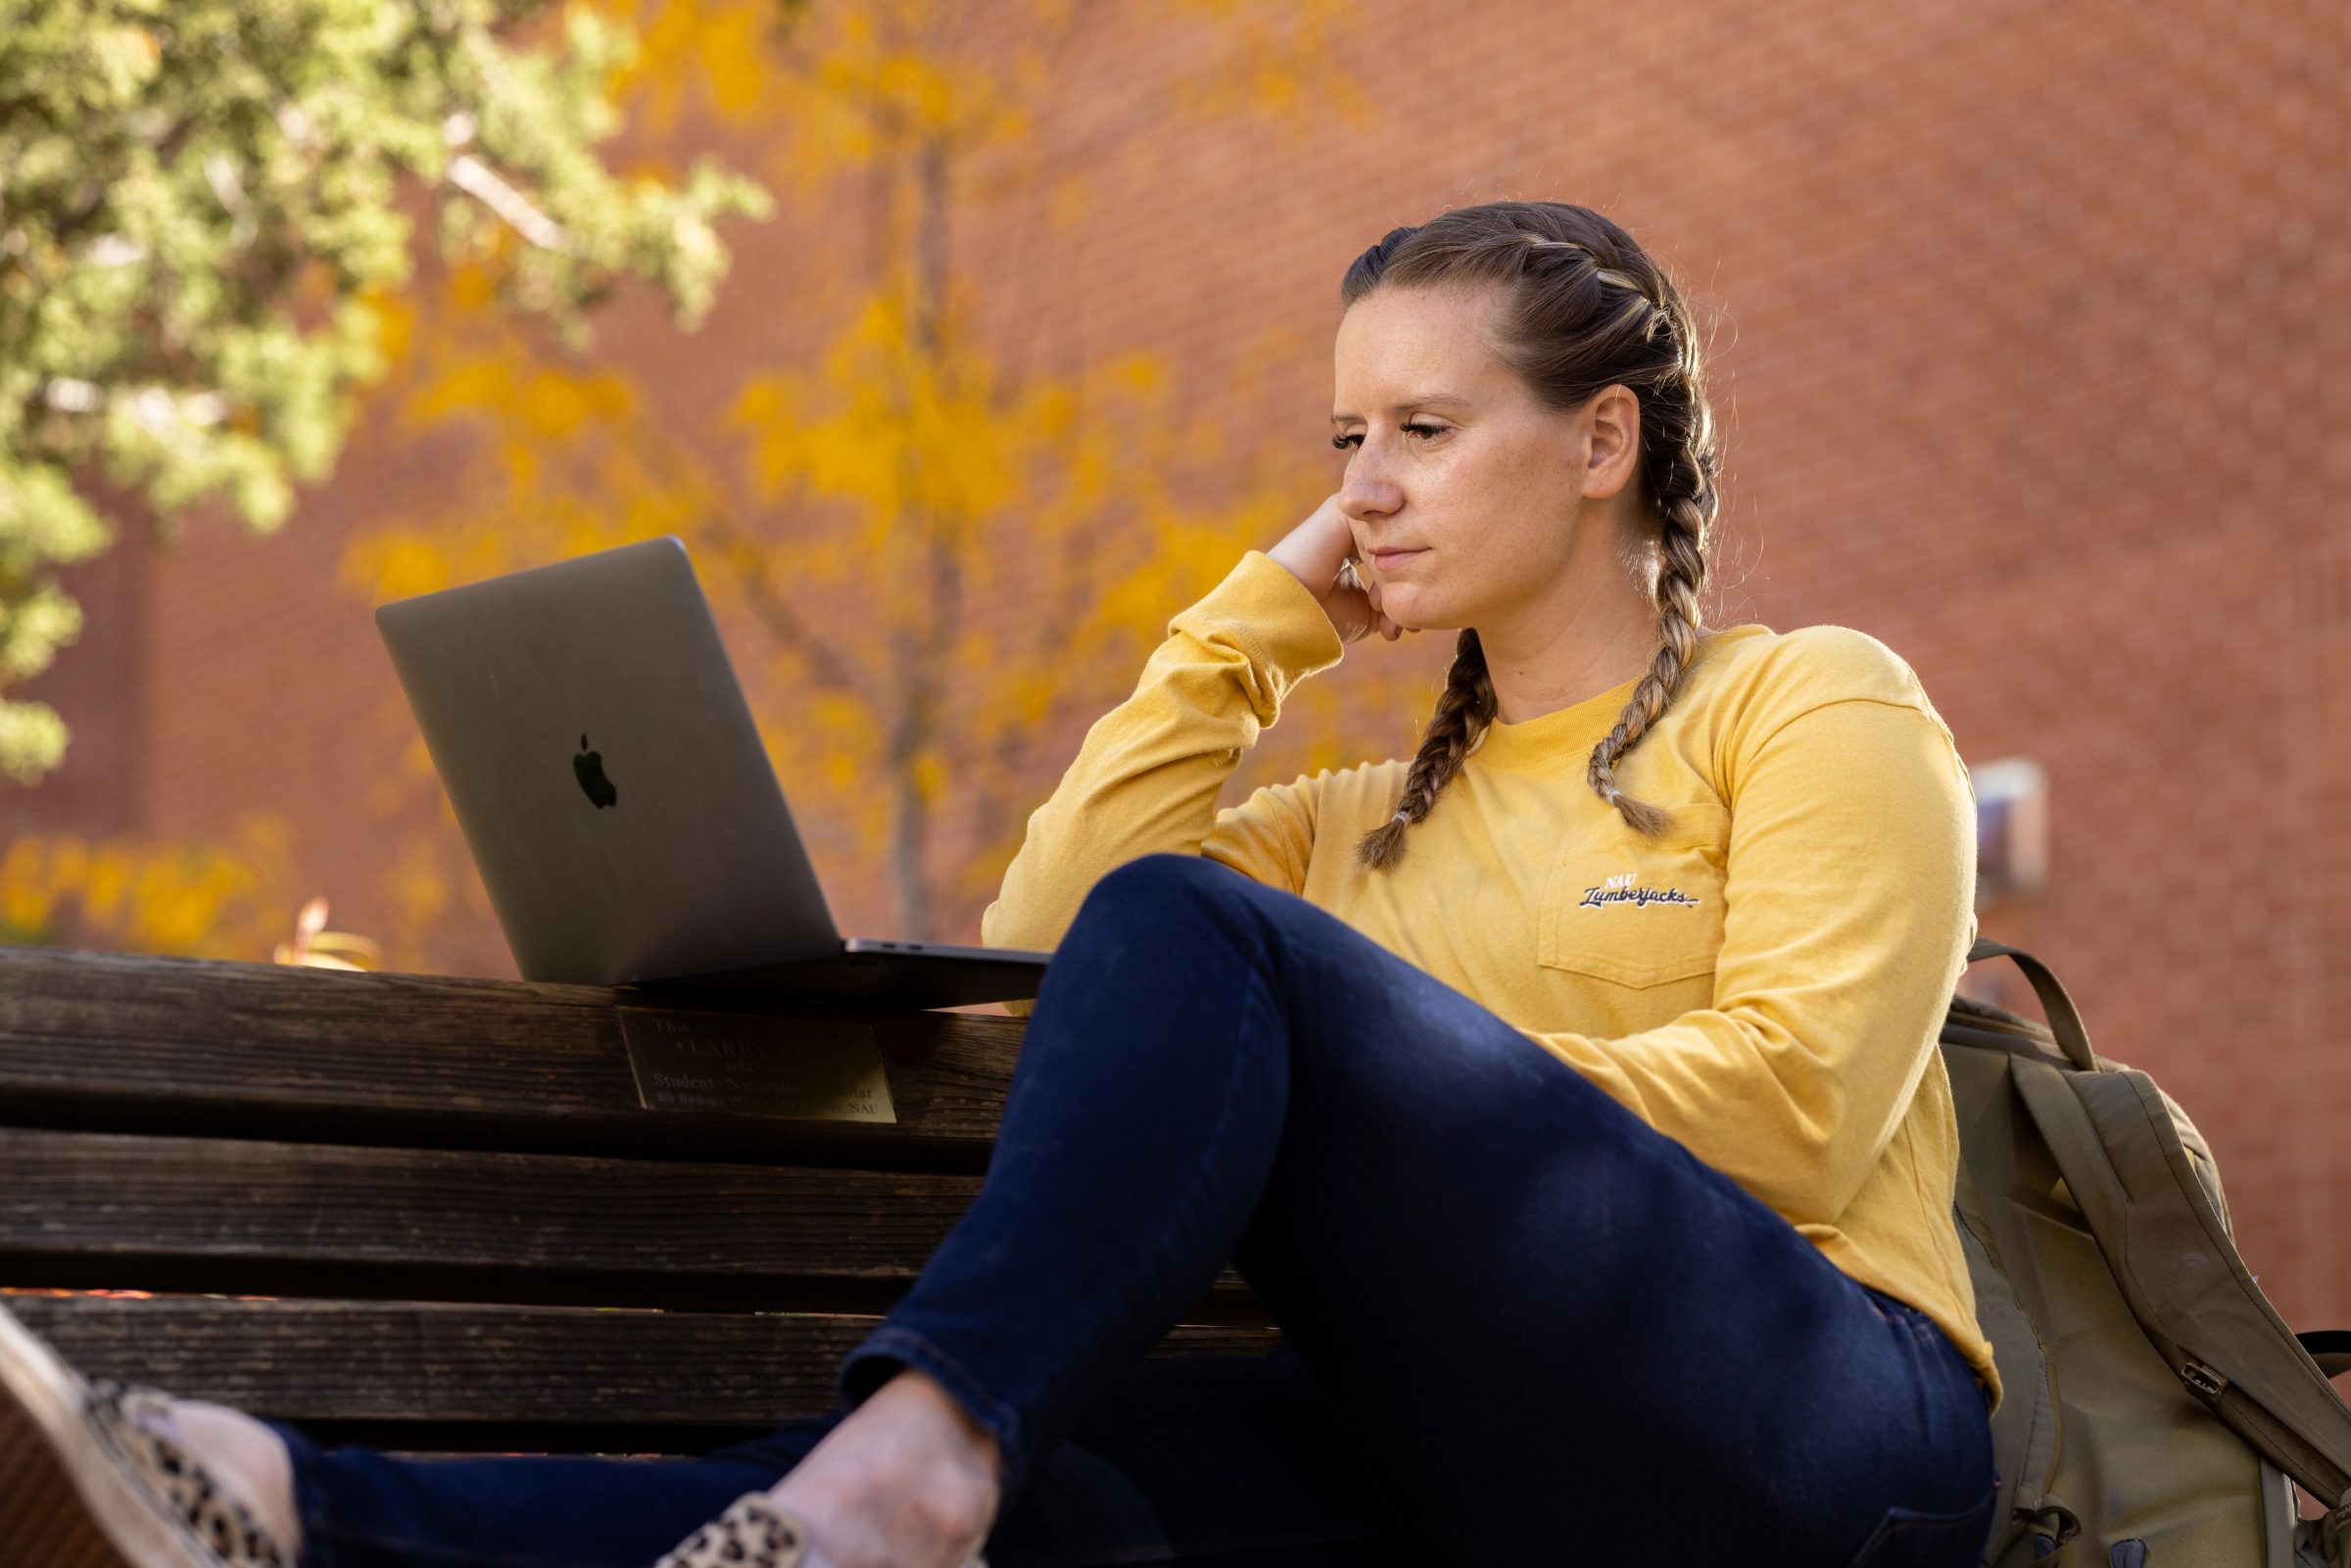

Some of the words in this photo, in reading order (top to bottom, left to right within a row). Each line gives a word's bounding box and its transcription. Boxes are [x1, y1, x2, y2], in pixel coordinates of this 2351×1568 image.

[1605, 873, 1638, 889] NAU
[1578, 885, 1701, 909] Lumberjacks
[650, 1018, 690, 1033] This
[690, 1039, 767, 1058] LARRY
[652, 1072, 715, 1090] Student
[678, 1092, 725, 1109] Biology
[849, 1102, 879, 1115] NAU
